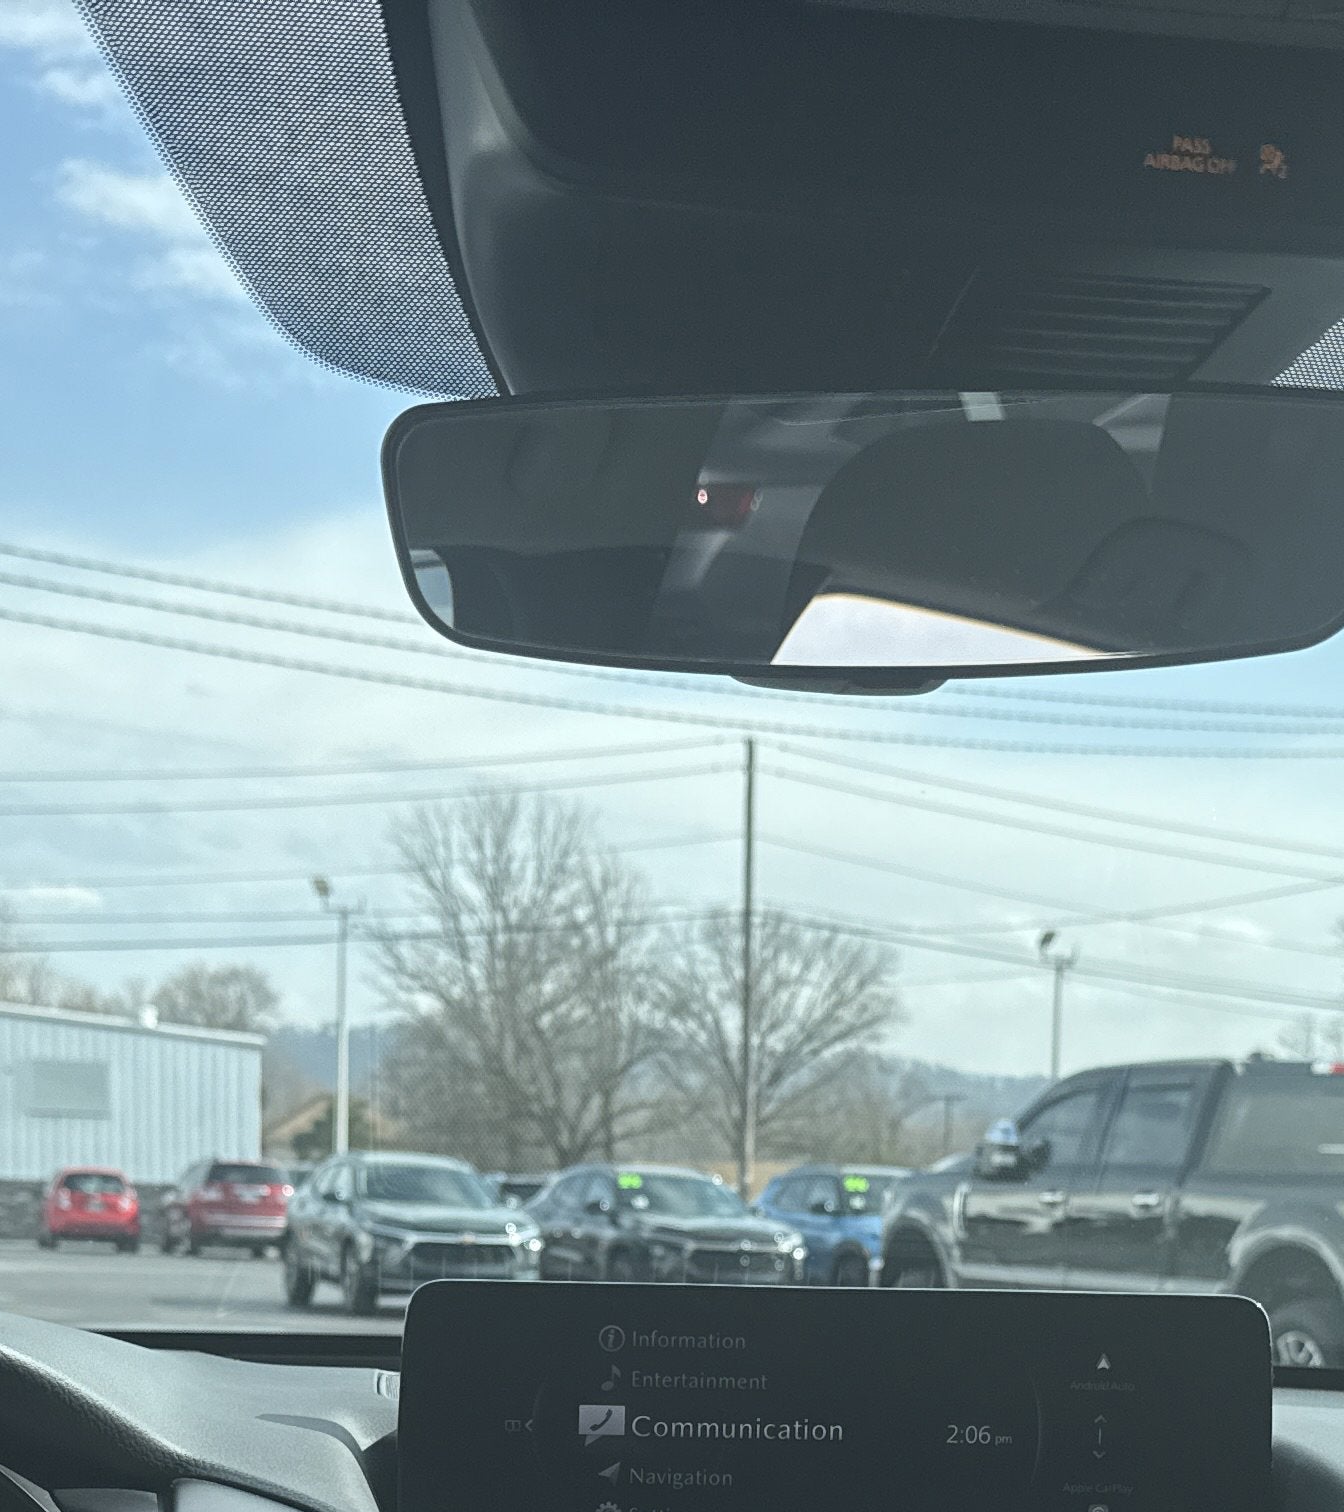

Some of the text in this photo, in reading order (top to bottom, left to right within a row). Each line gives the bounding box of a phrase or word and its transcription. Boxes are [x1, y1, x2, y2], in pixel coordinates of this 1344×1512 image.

[1173, 136, 1210, 154] PASS
[1143, 153, 1205, 172] AIRBAG
[632, 1330, 746, 1350] Information
[631, 1370, 768, 1390] Entertainment
[631, 1415, 844, 1441] Communication
[945, 1424, 1013, 1446] 2:06 pm
[628, 1467, 733, 1490] Navigation
